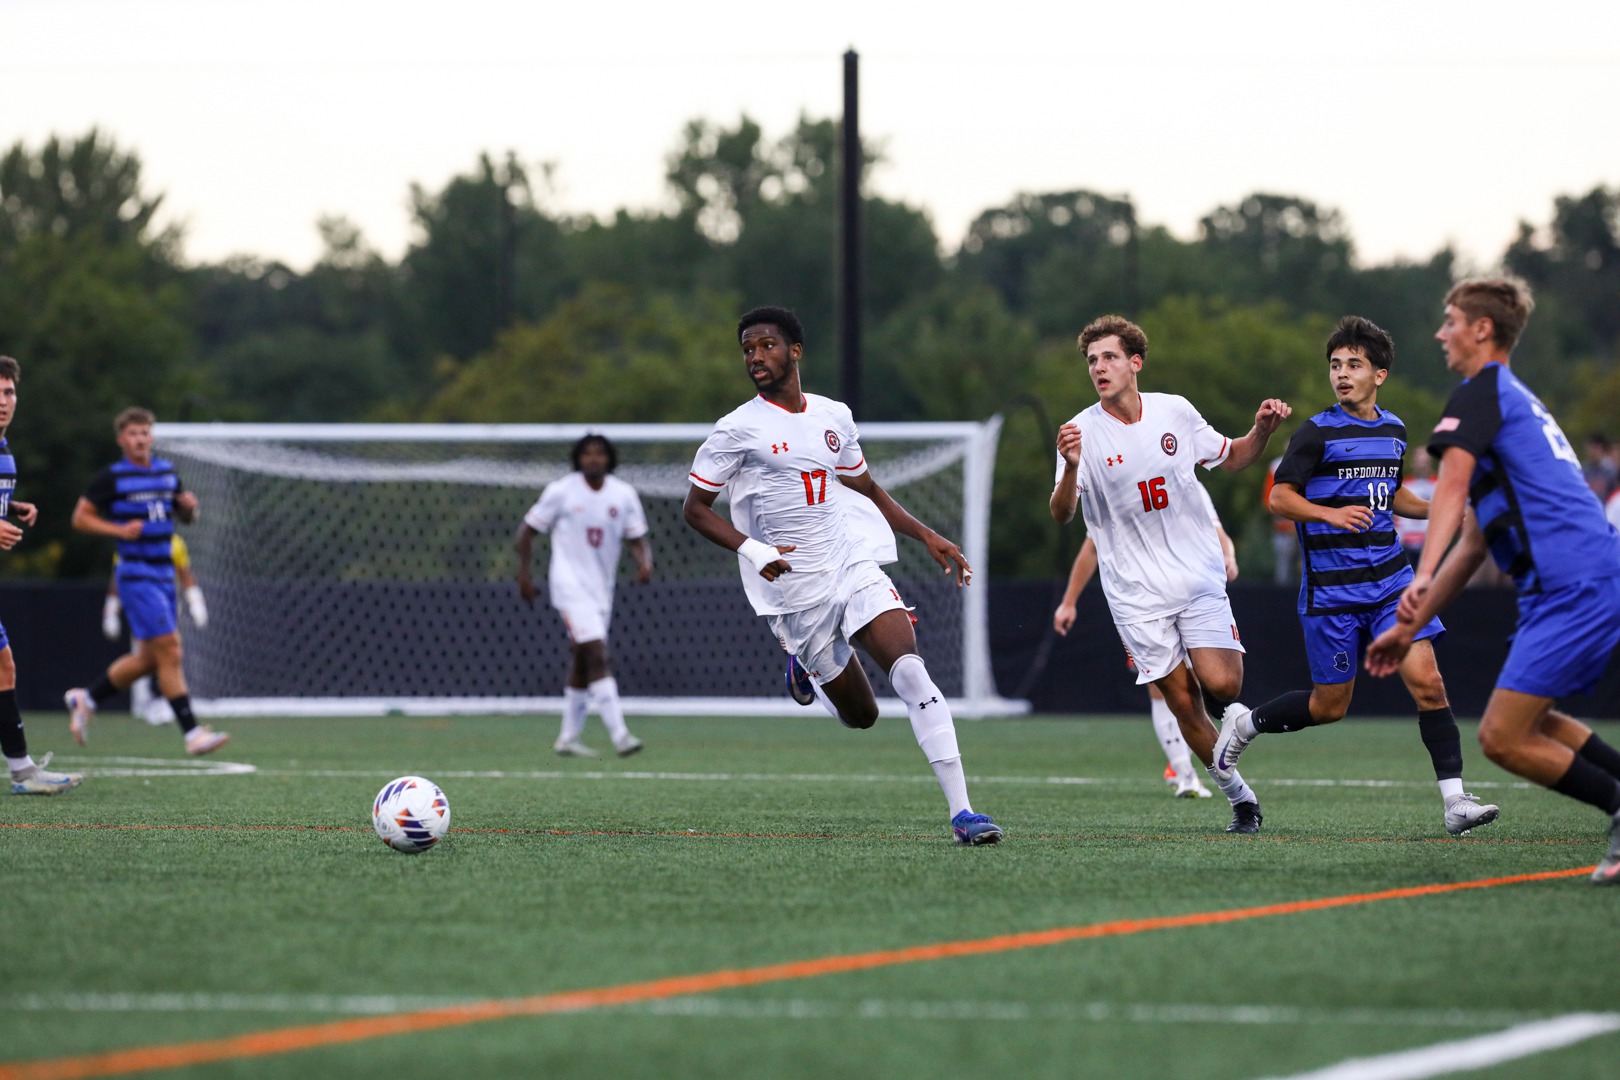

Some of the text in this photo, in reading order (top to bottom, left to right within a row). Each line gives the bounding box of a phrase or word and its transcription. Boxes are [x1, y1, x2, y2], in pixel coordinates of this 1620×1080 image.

[801, 469, 827, 506] 17
[1338, 466, 1386, 480] FREDONIA
[1137, 475, 1169, 513] 16
[1367, 481, 1389, 511] 10
